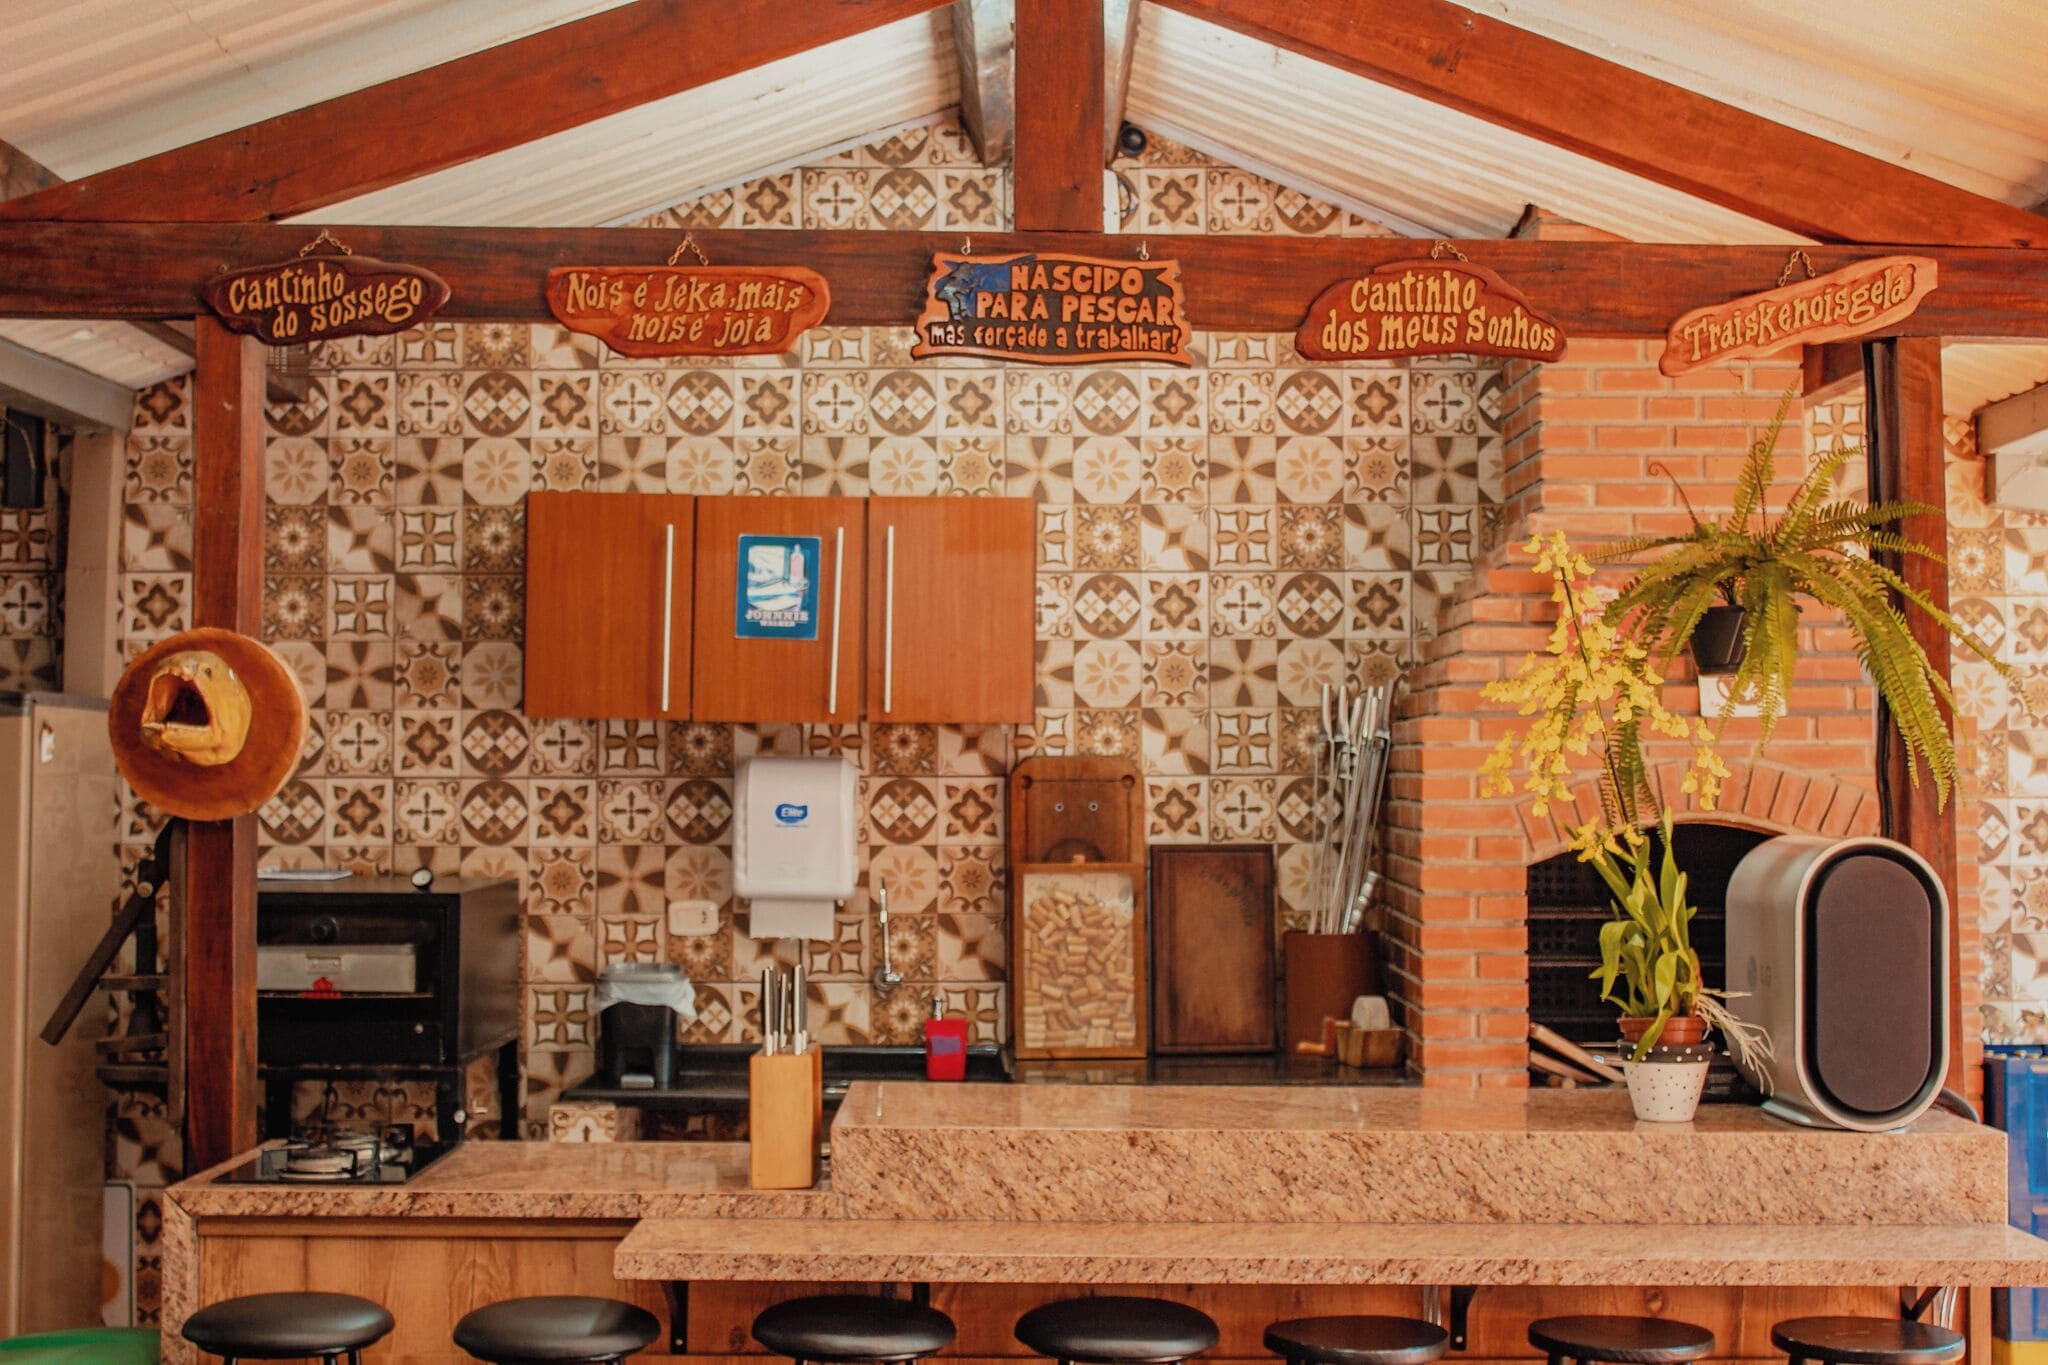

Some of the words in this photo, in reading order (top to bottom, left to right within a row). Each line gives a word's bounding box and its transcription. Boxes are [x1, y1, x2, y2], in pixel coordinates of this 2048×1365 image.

[229, 261, 345, 314] Cantinho
[566, 272, 624, 313] Nois
[633, 274, 653, 308] é
[1010, 264, 1144, 296] NASCIDO
[1351, 270, 1476, 314] Cantinho
[272, 306, 299, 338] do
[975, 291, 1049, 321] PARA
[1061, 294, 1175, 327] PESCAR
[713, 312, 773, 348] joia
[930, 323, 966, 345] mas
[974, 324, 1048, 351] forçado
[1055, 327, 1068, 349] a
[1075, 324, 1181, 354] trabalhar!
[1321, 309, 1370, 353] dos
[1377, 313, 1458, 352] meus
